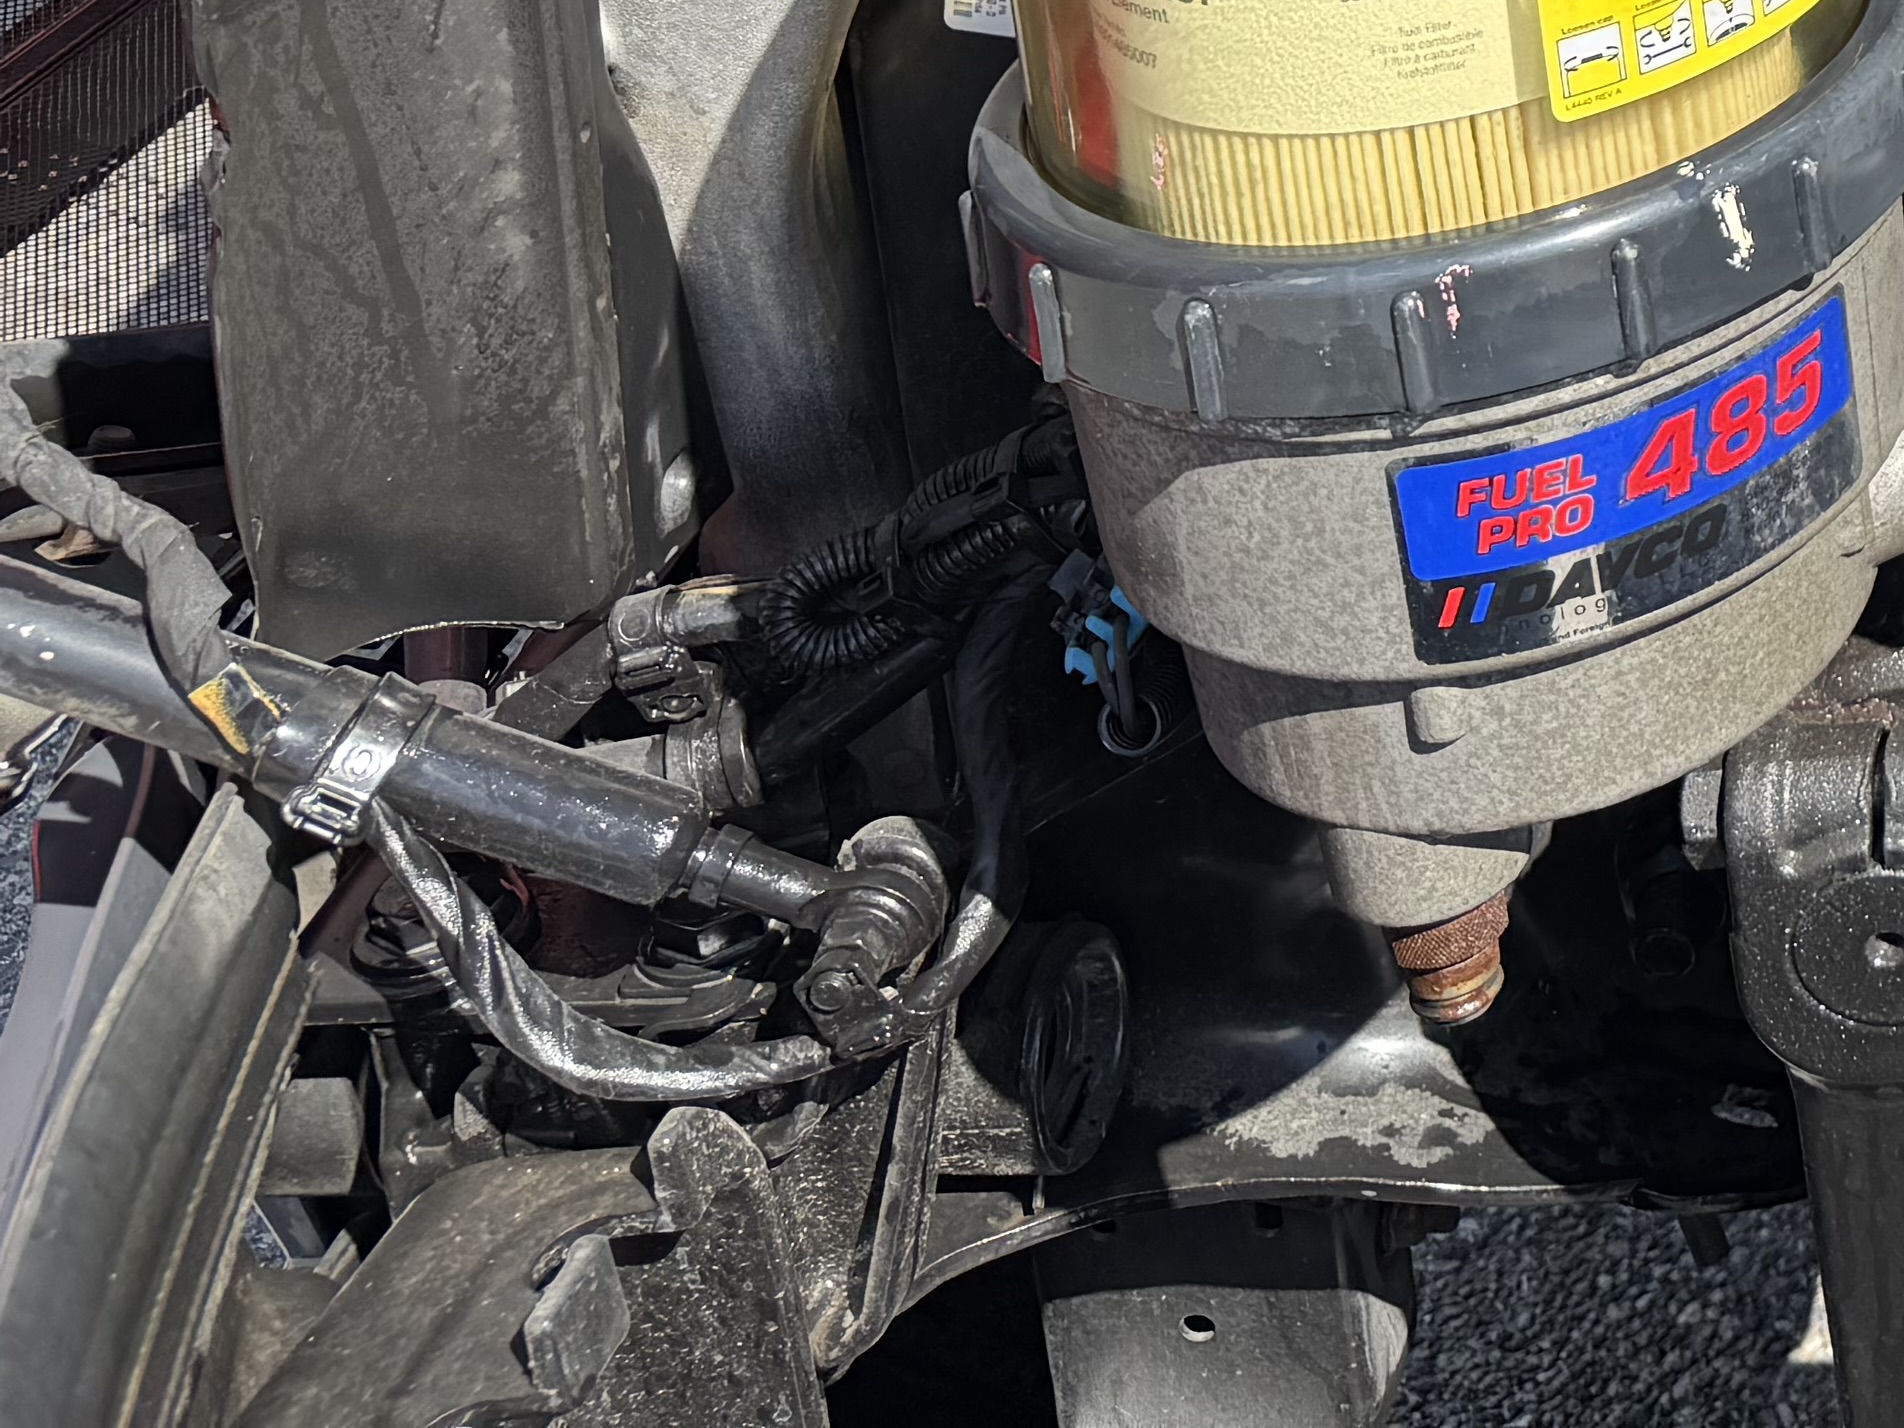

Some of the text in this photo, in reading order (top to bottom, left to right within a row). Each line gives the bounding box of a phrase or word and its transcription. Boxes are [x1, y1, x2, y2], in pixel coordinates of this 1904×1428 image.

[1624, 329, 1824, 502] 485
[1456, 453, 1597, 519] FUEL
[1477, 495, 1595, 555] PRO
[1504, 503, 1728, 618] DAYCO
